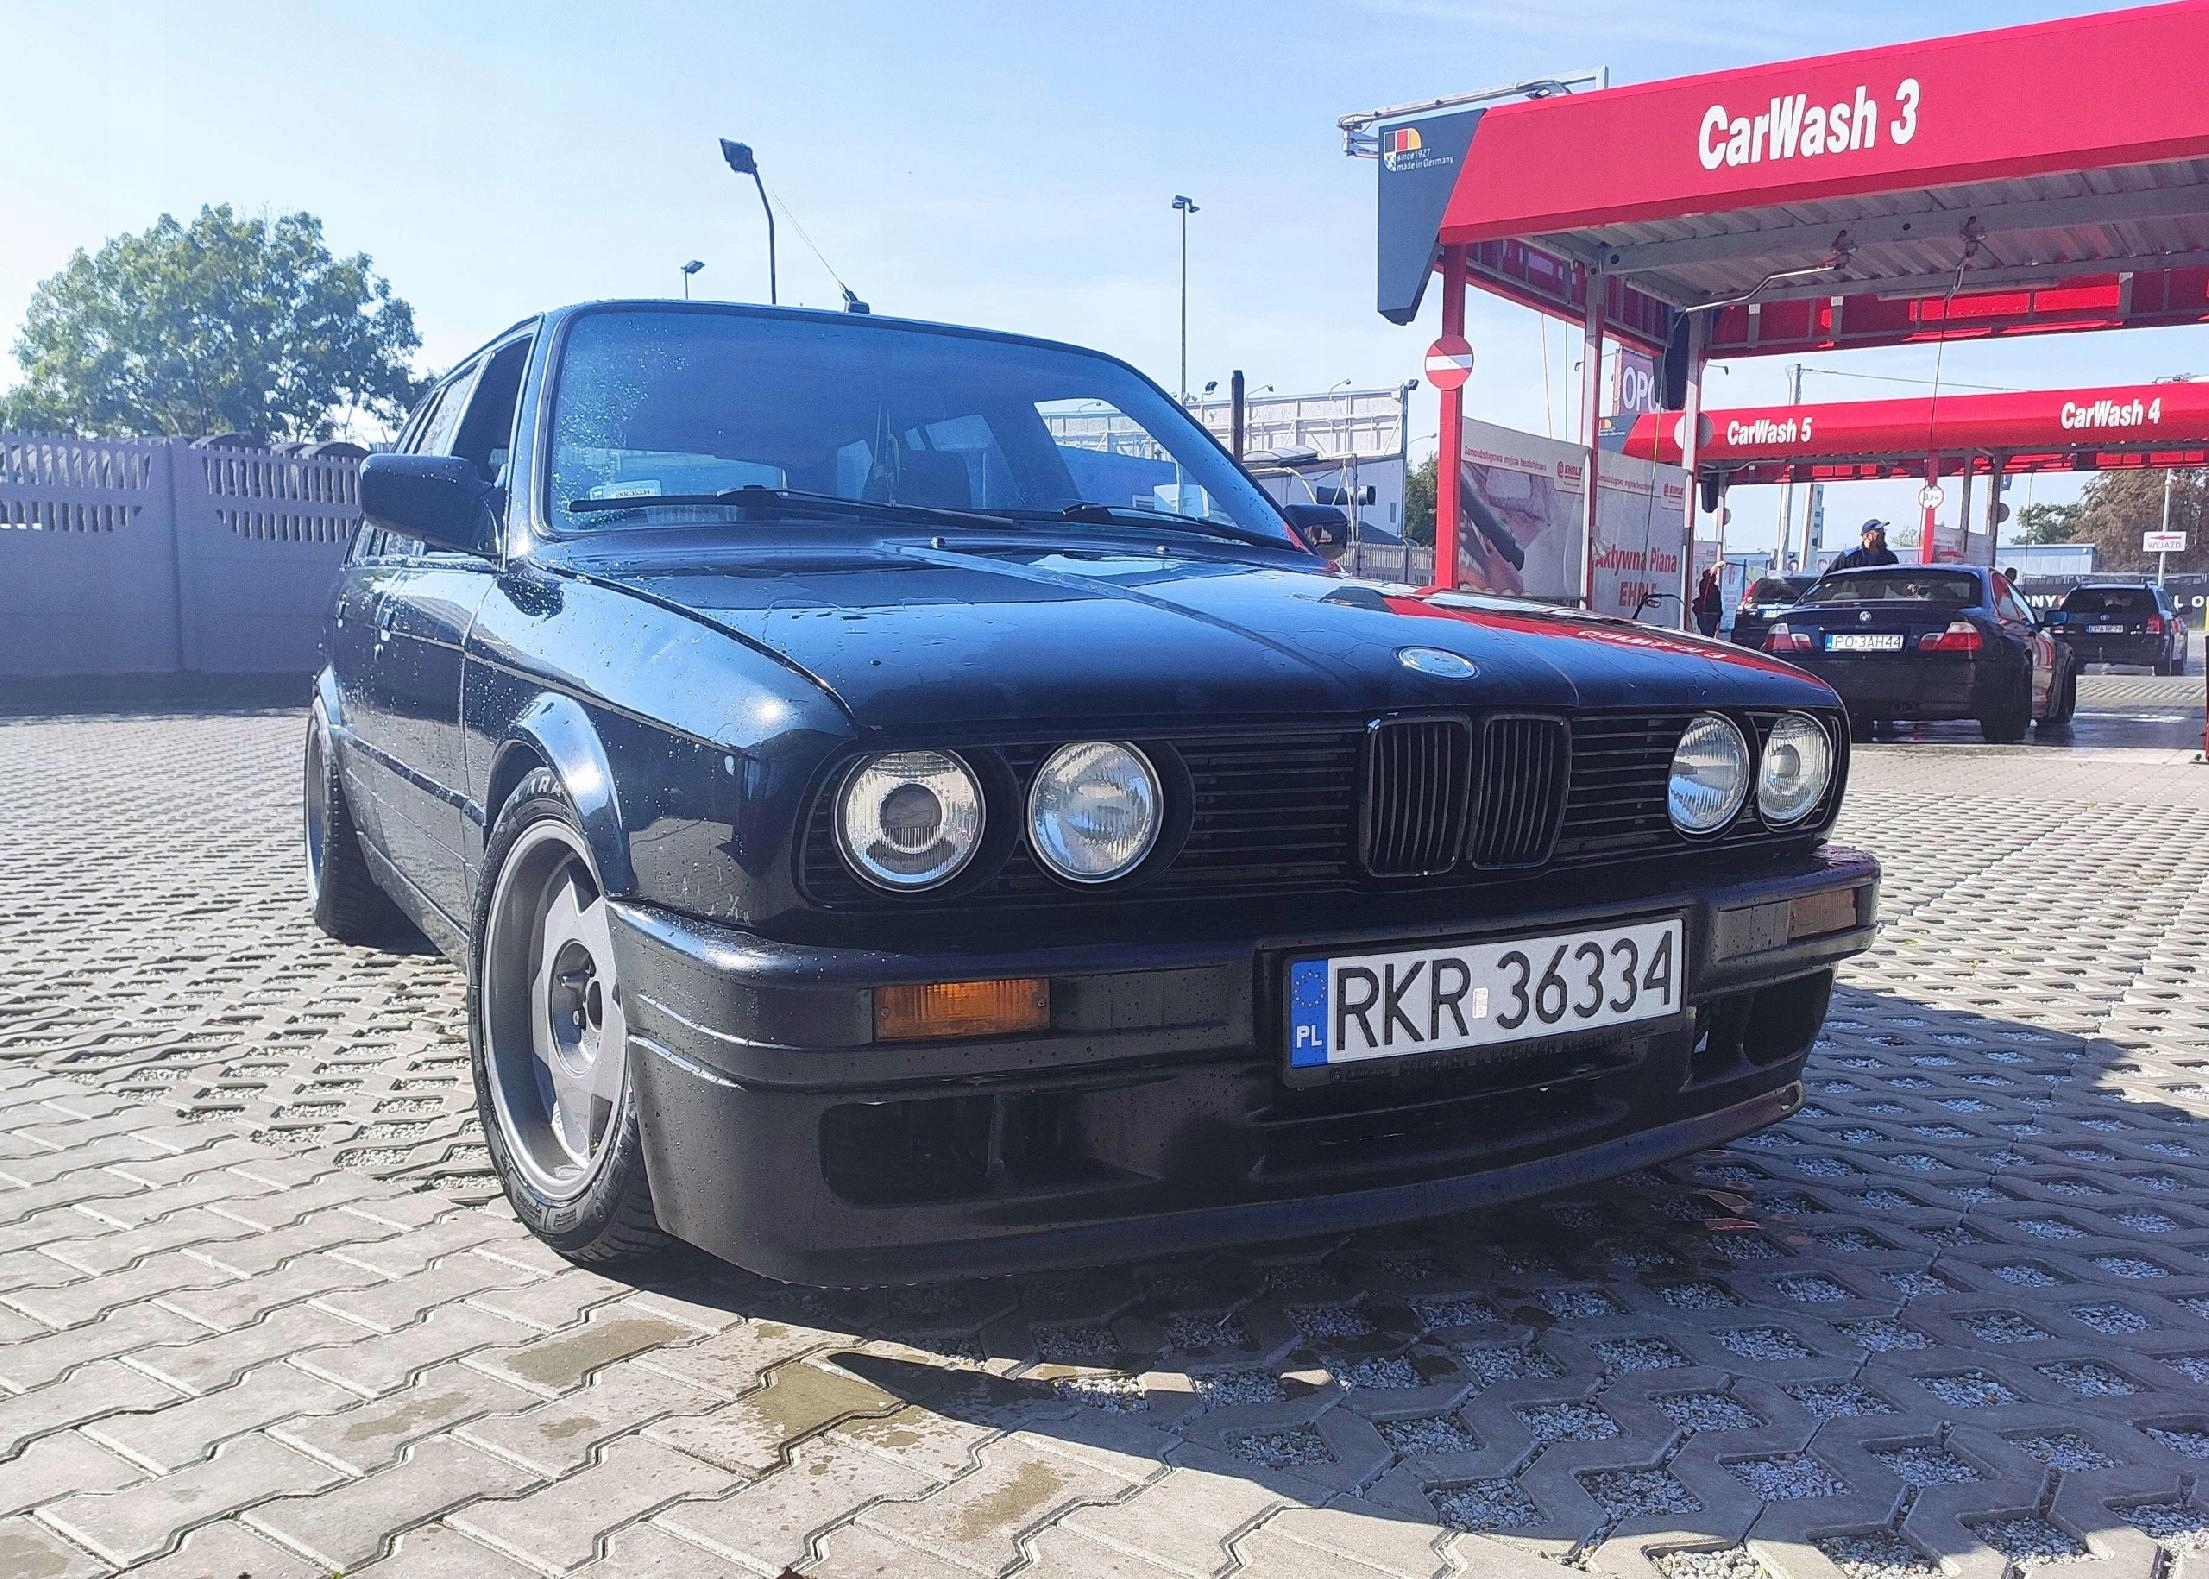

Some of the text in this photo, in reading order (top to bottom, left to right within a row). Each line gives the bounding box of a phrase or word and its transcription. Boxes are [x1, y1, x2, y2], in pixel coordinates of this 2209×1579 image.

[1698, 77, 1920, 170] CarWash 3
[2061, 397, 2161, 429] CarWash 4
[1727, 416, 1813, 446] CarWash 5
[1649, 546, 1677, 572] Piana
[1335, 930, 1673, 1051] RKR 36334
[1296, 1024, 1322, 1048] PL
